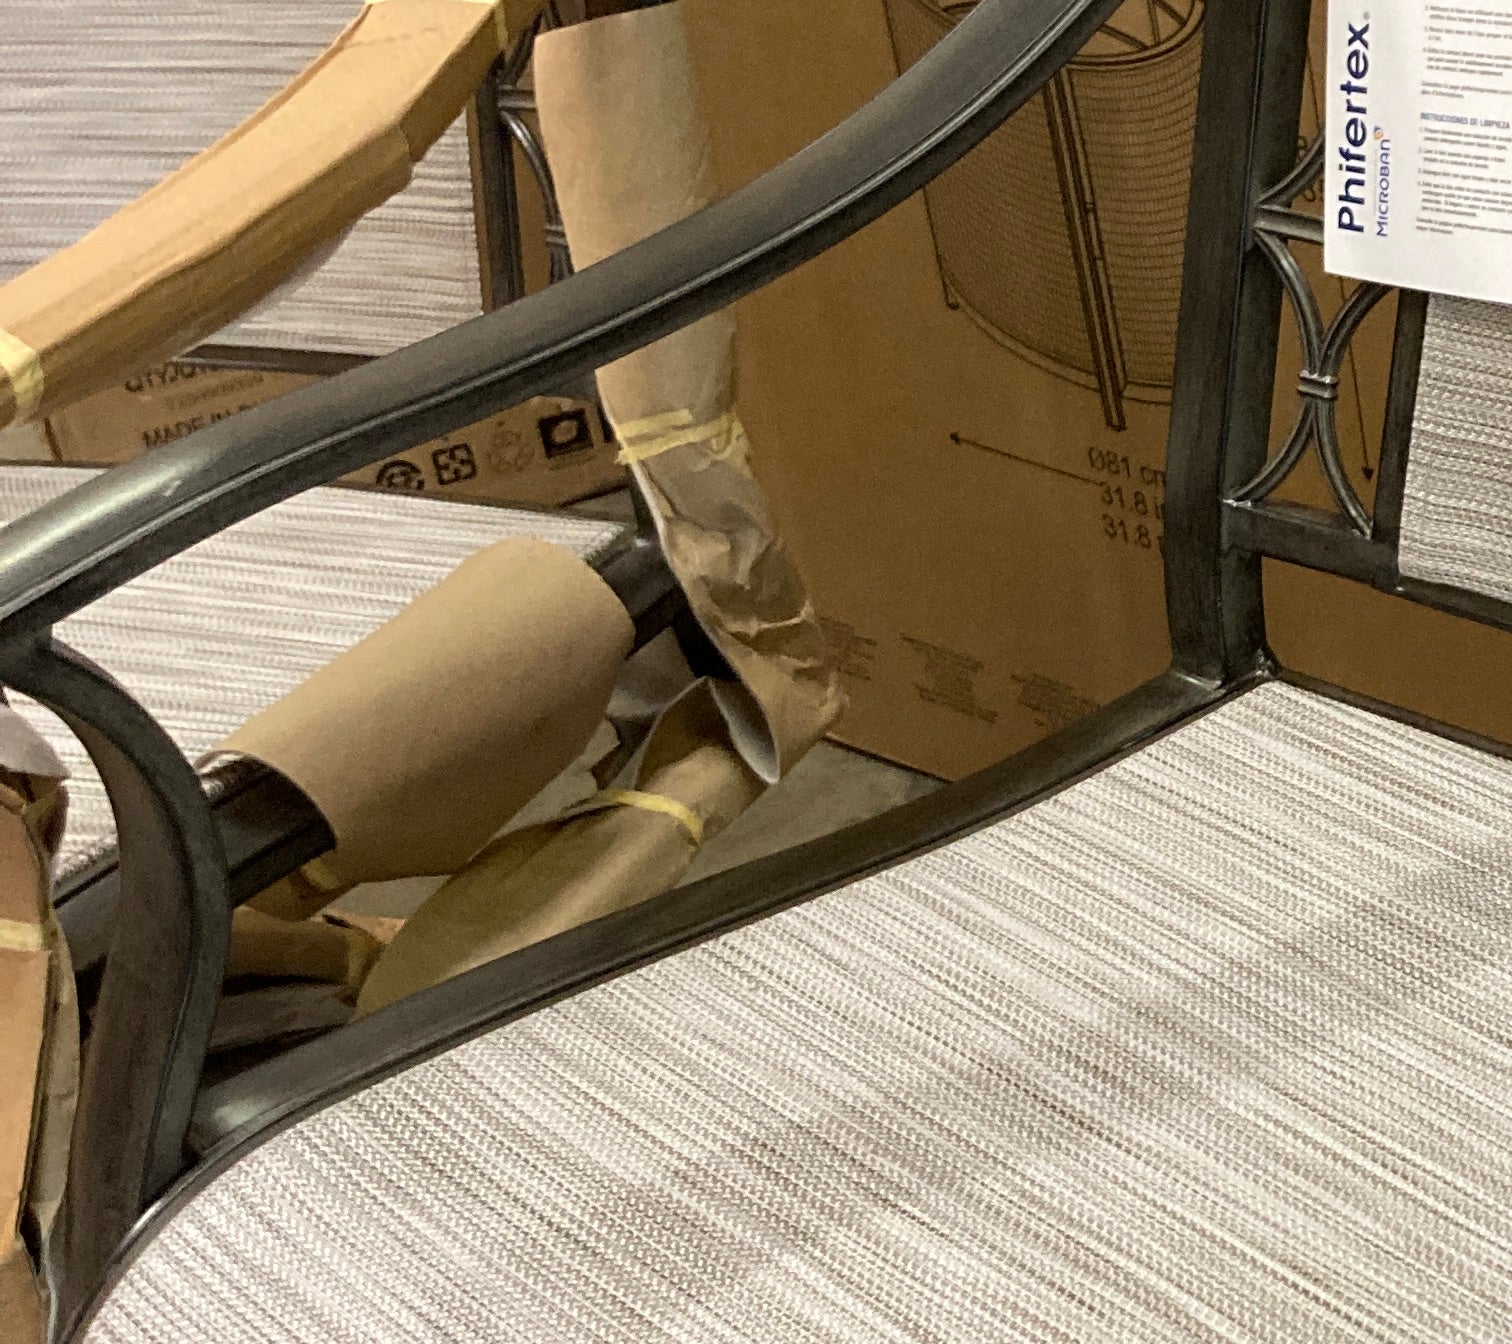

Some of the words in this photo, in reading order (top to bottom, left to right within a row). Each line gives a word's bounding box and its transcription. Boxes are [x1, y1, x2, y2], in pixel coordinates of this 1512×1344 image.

[1337, 22, 1371, 234] Phifertex
[1100, 481, 1149, 516] 31.8
[1102, 513, 1152, 549] 31.8
